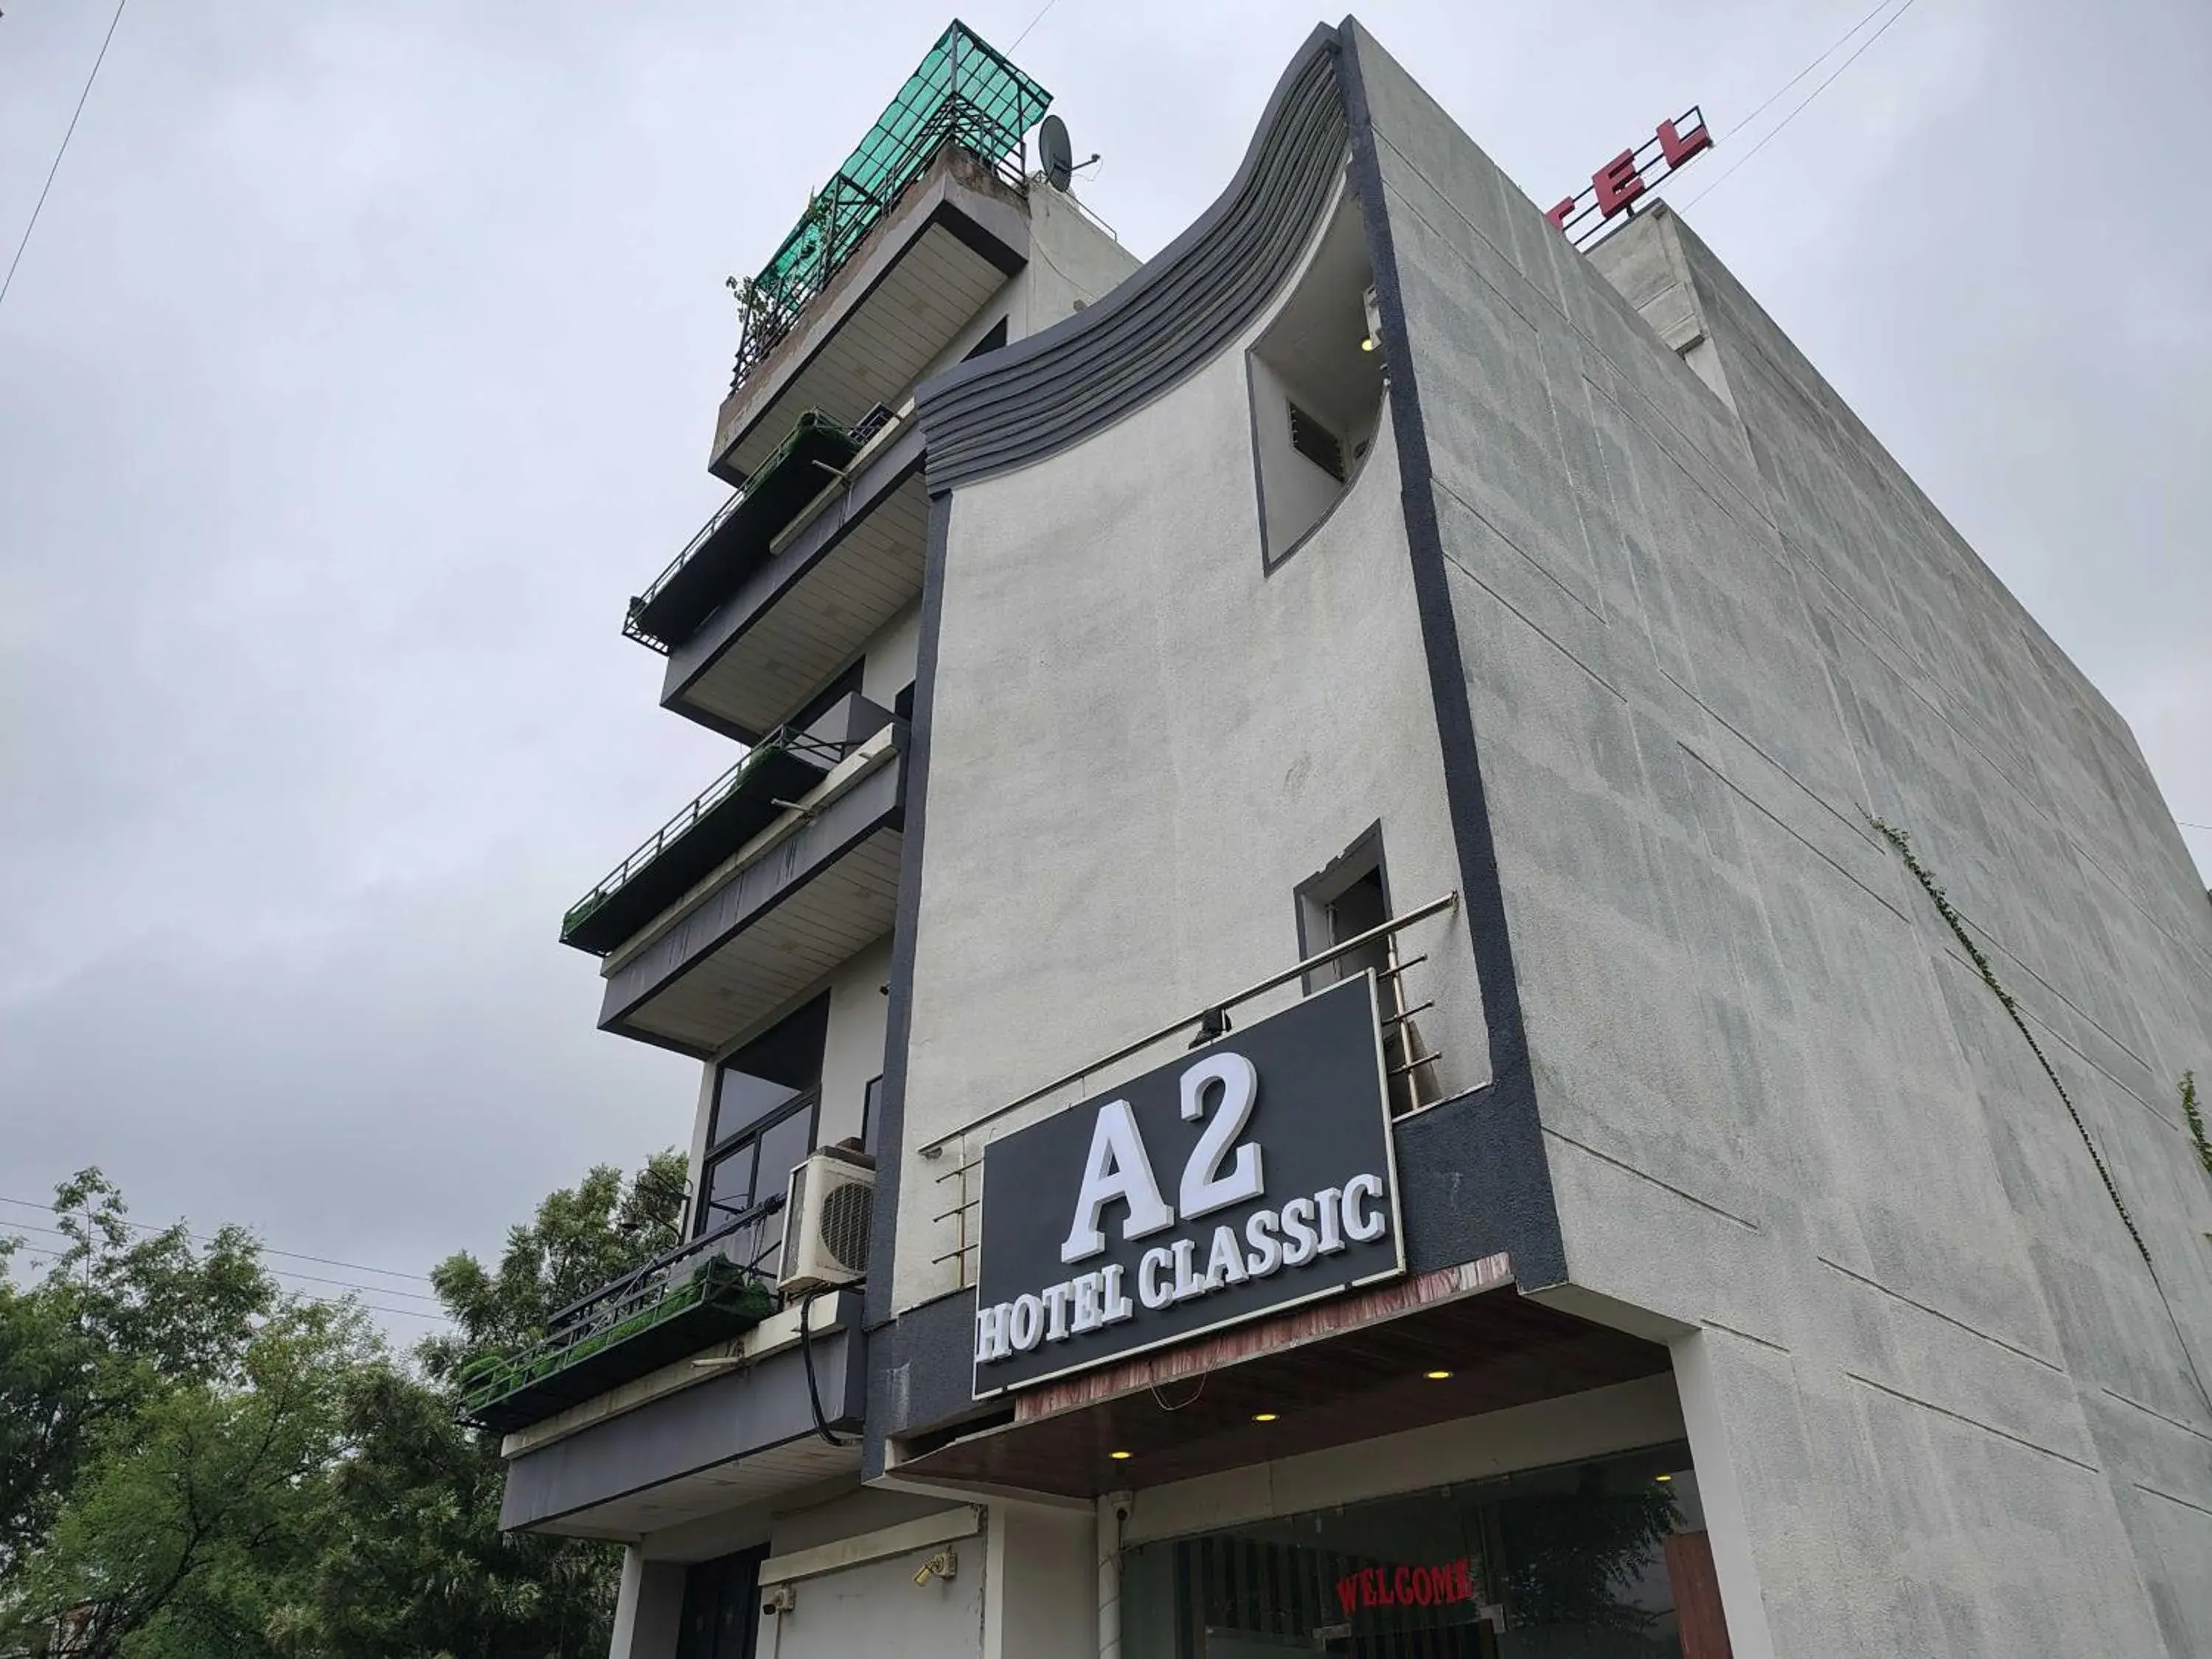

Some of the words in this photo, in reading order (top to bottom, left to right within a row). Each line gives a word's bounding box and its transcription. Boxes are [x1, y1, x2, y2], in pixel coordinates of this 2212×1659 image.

[1061, 1052, 1264, 1263] A2
[975, 1265, 1133, 1363] HOTEL
[1138, 1174, 1385, 1309] CLASSIC
[1337, 1557, 1474, 1616] WELCOME
